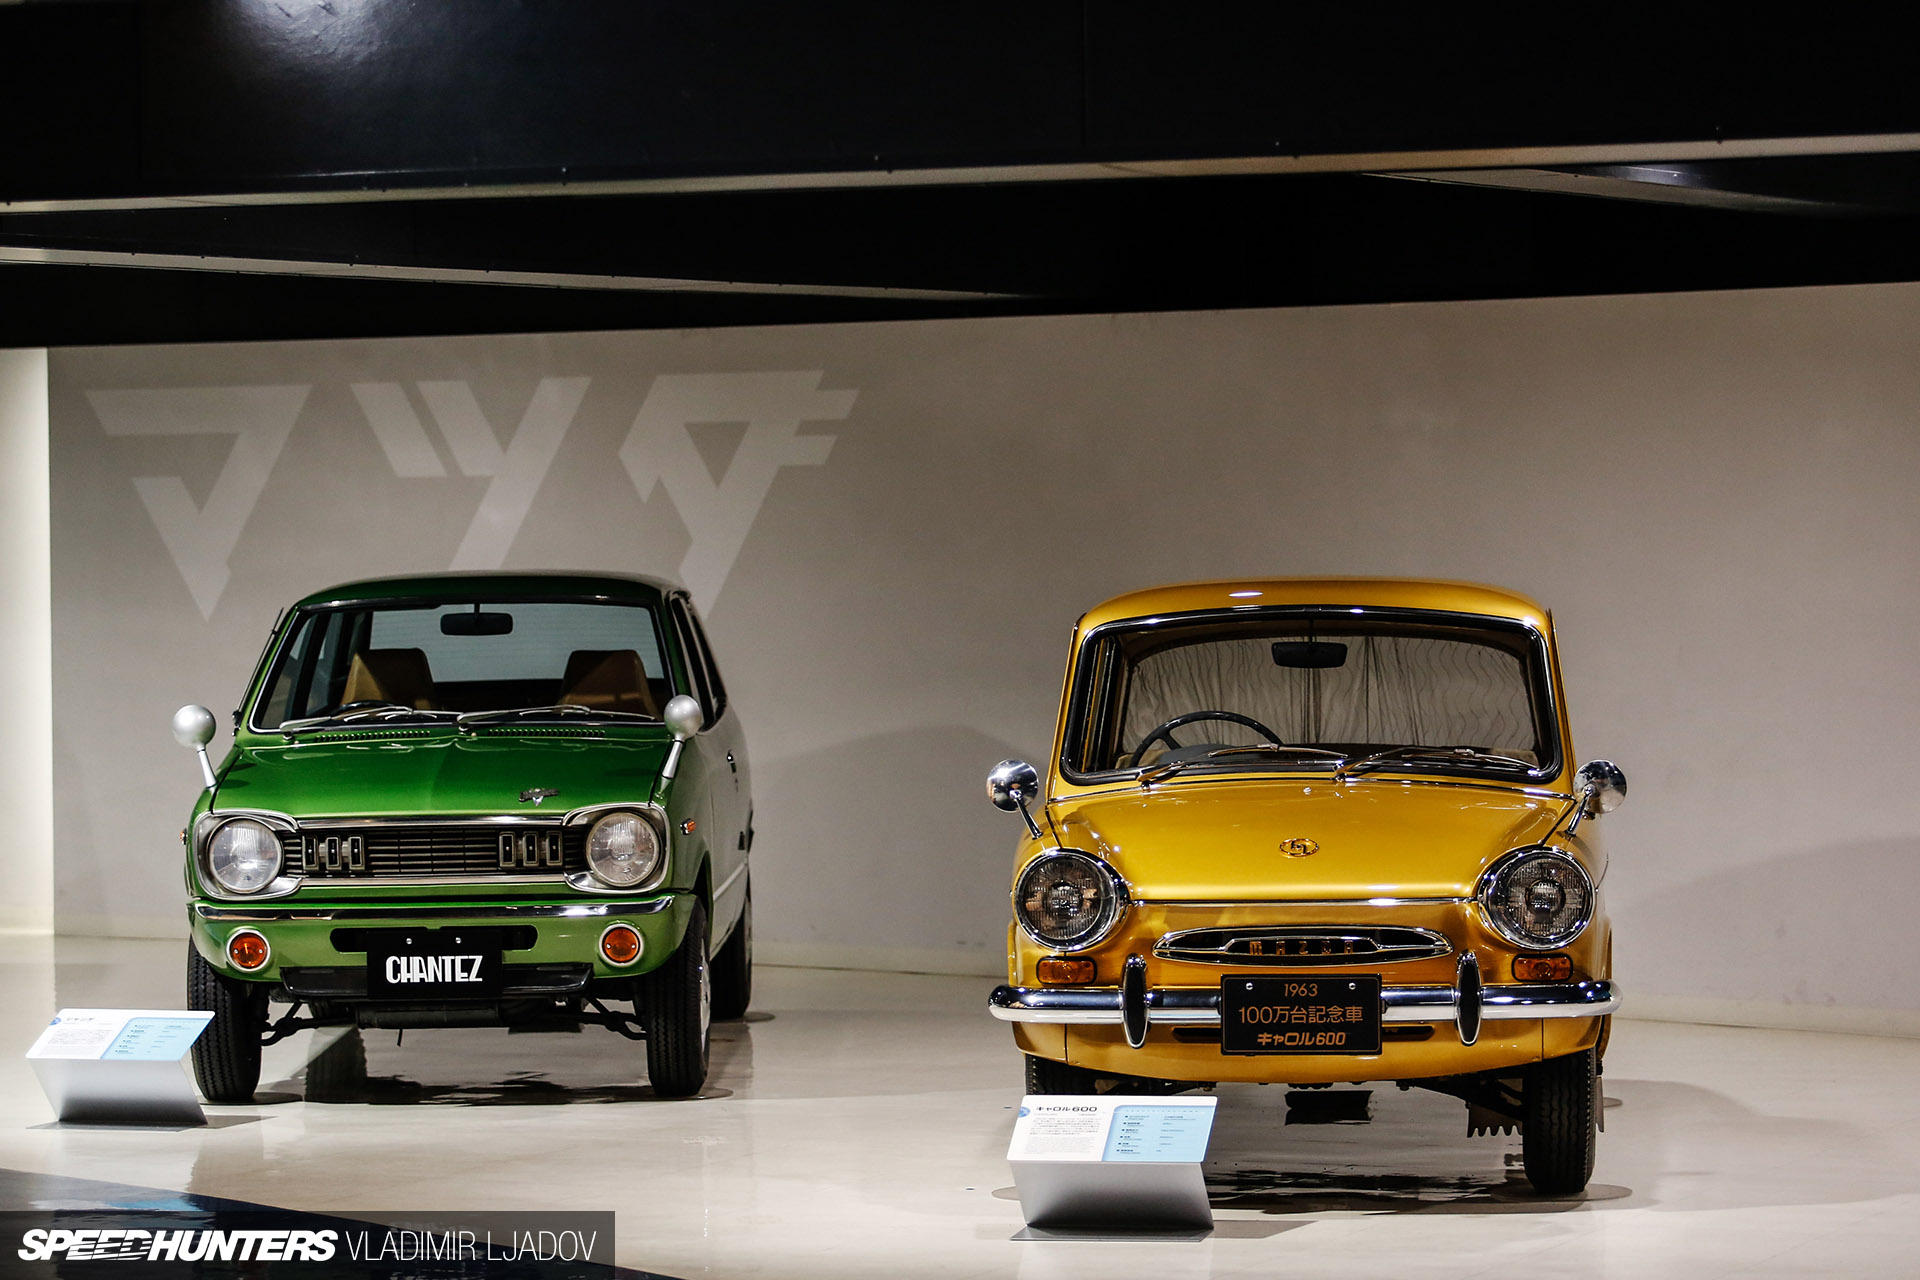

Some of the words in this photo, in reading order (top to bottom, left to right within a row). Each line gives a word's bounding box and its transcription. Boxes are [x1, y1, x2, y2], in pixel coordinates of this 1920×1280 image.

[1249, 941, 1354, 955] MAZDA
[385, 955, 483, 984] CHANTEZ
[1284, 983, 1318, 997] 1963
[1239, 1006, 1363, 1023] 100万台記念車
[1257, 1031, 1346, 1046] キャロル600
